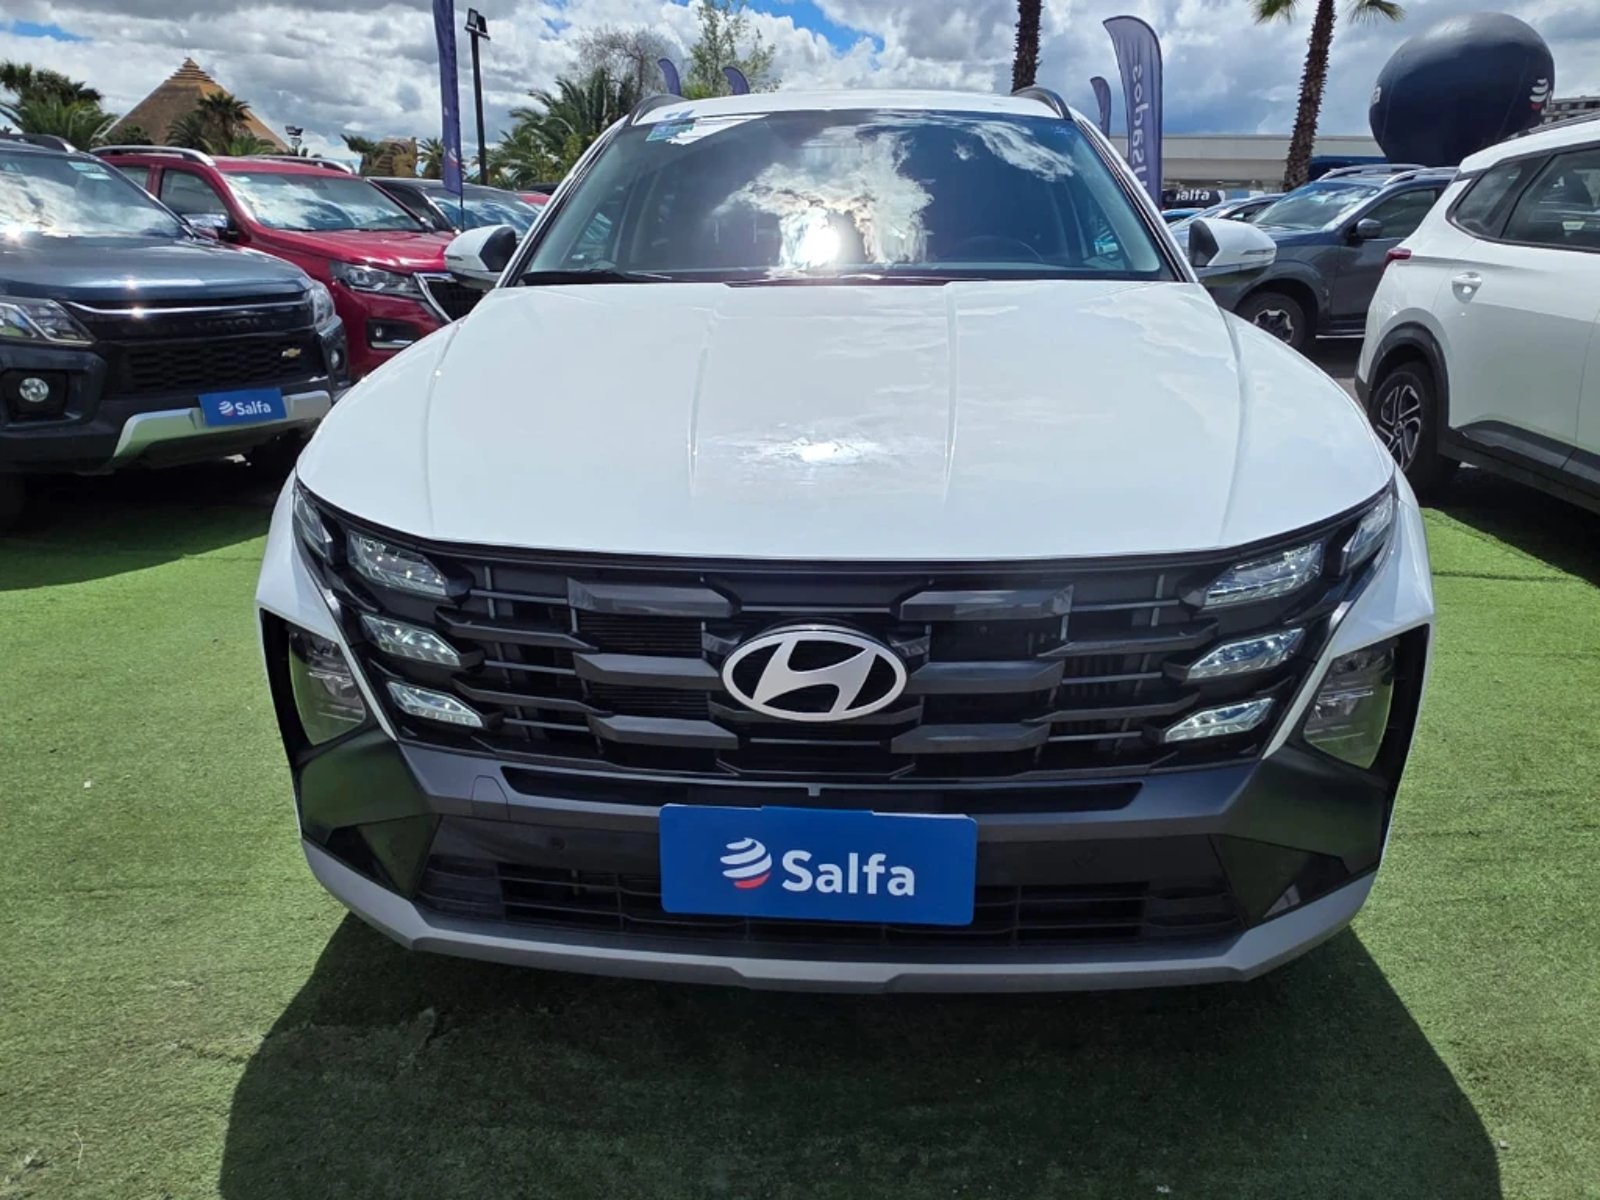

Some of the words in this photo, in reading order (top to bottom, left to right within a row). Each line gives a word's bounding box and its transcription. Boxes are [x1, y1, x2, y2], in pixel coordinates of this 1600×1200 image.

[1176, 188, 1210, 201] alfa
[235, 400, 272, 416] Salfa
[781, 849, 915, 896] Salfa
